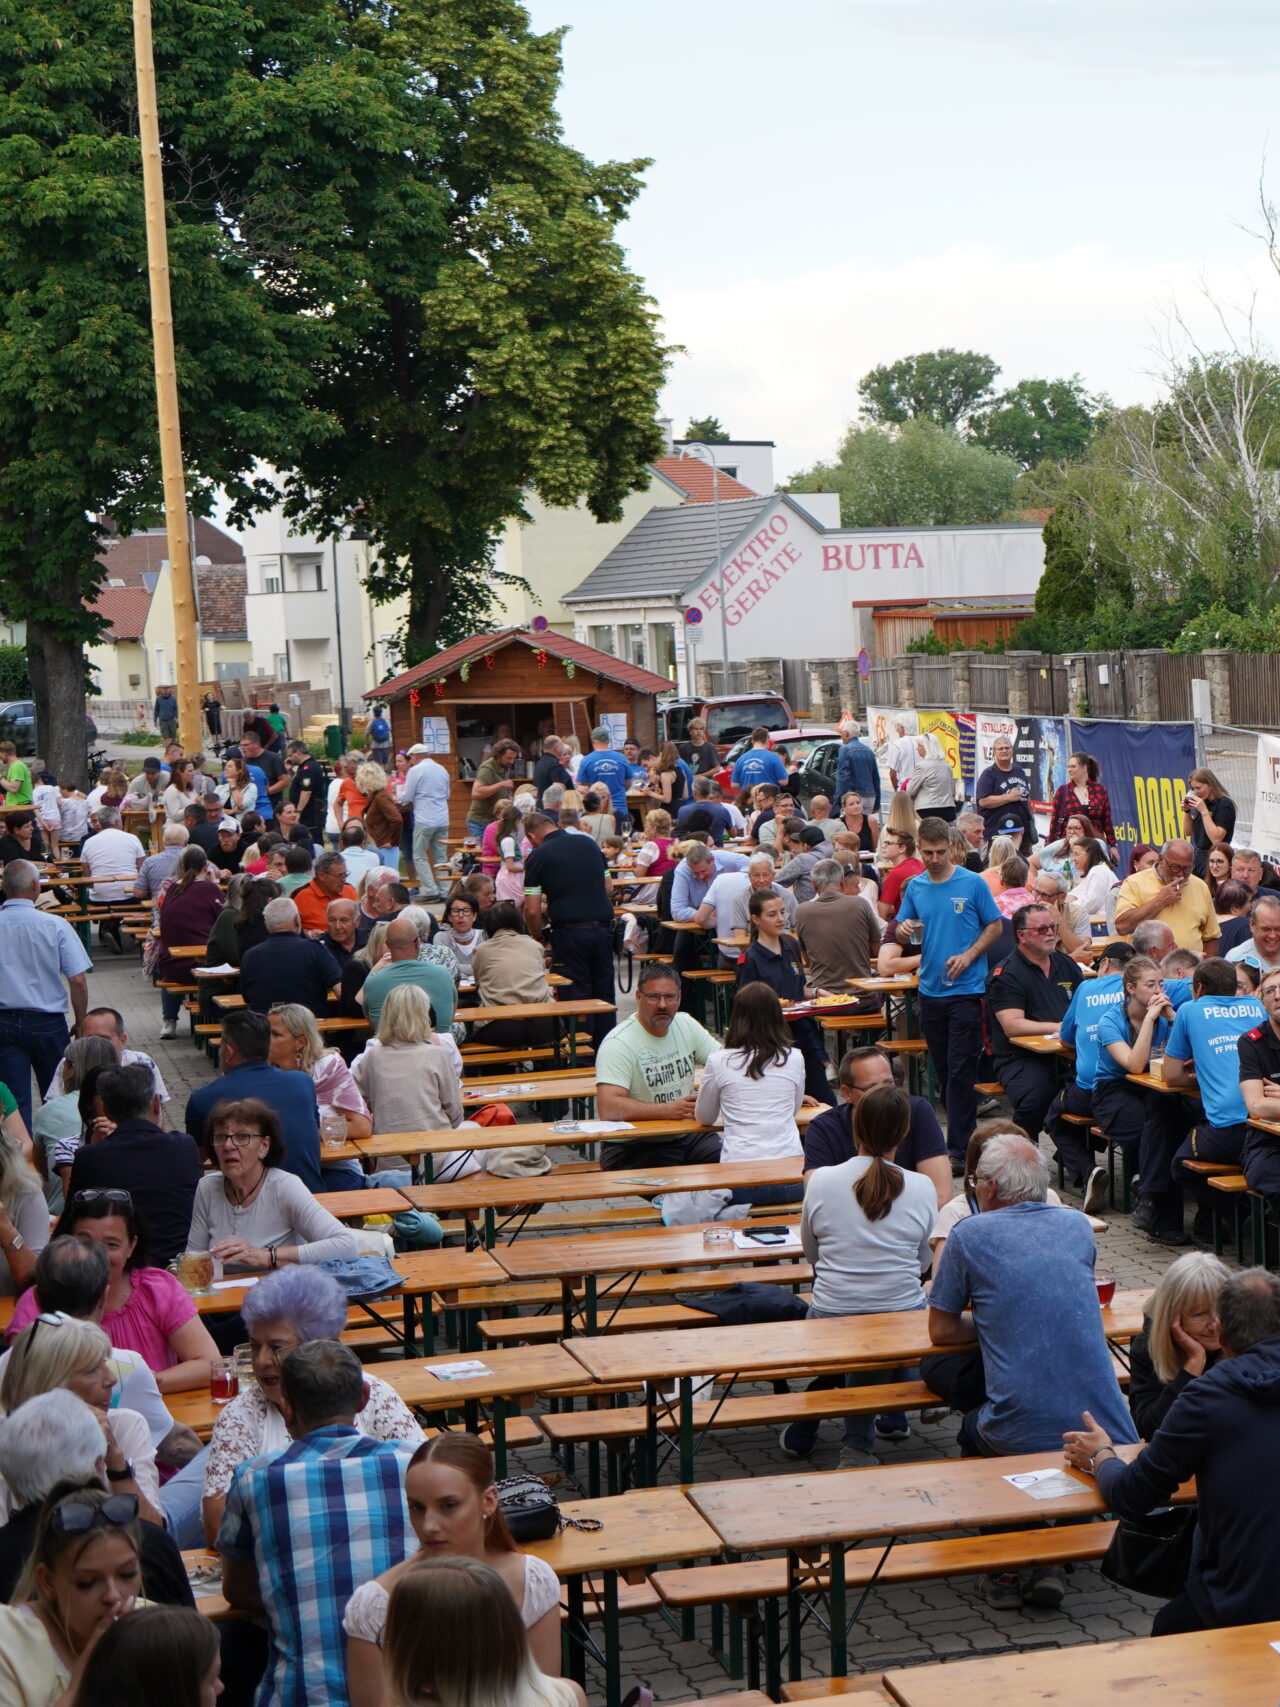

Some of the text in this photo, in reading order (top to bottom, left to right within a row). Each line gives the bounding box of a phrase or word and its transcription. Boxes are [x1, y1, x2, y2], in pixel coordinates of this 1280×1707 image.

[697, 513, 789, 611] ELEKTRO
[821, 542, 925, 572] BUTTA
[725, 542, 803, 627] GERÄTE
[1127, 822, 1138, 848] by
[1203, 1005, 1264, 1020] PEGOBUA
[645, 1062, 675, 1087] CAMP
